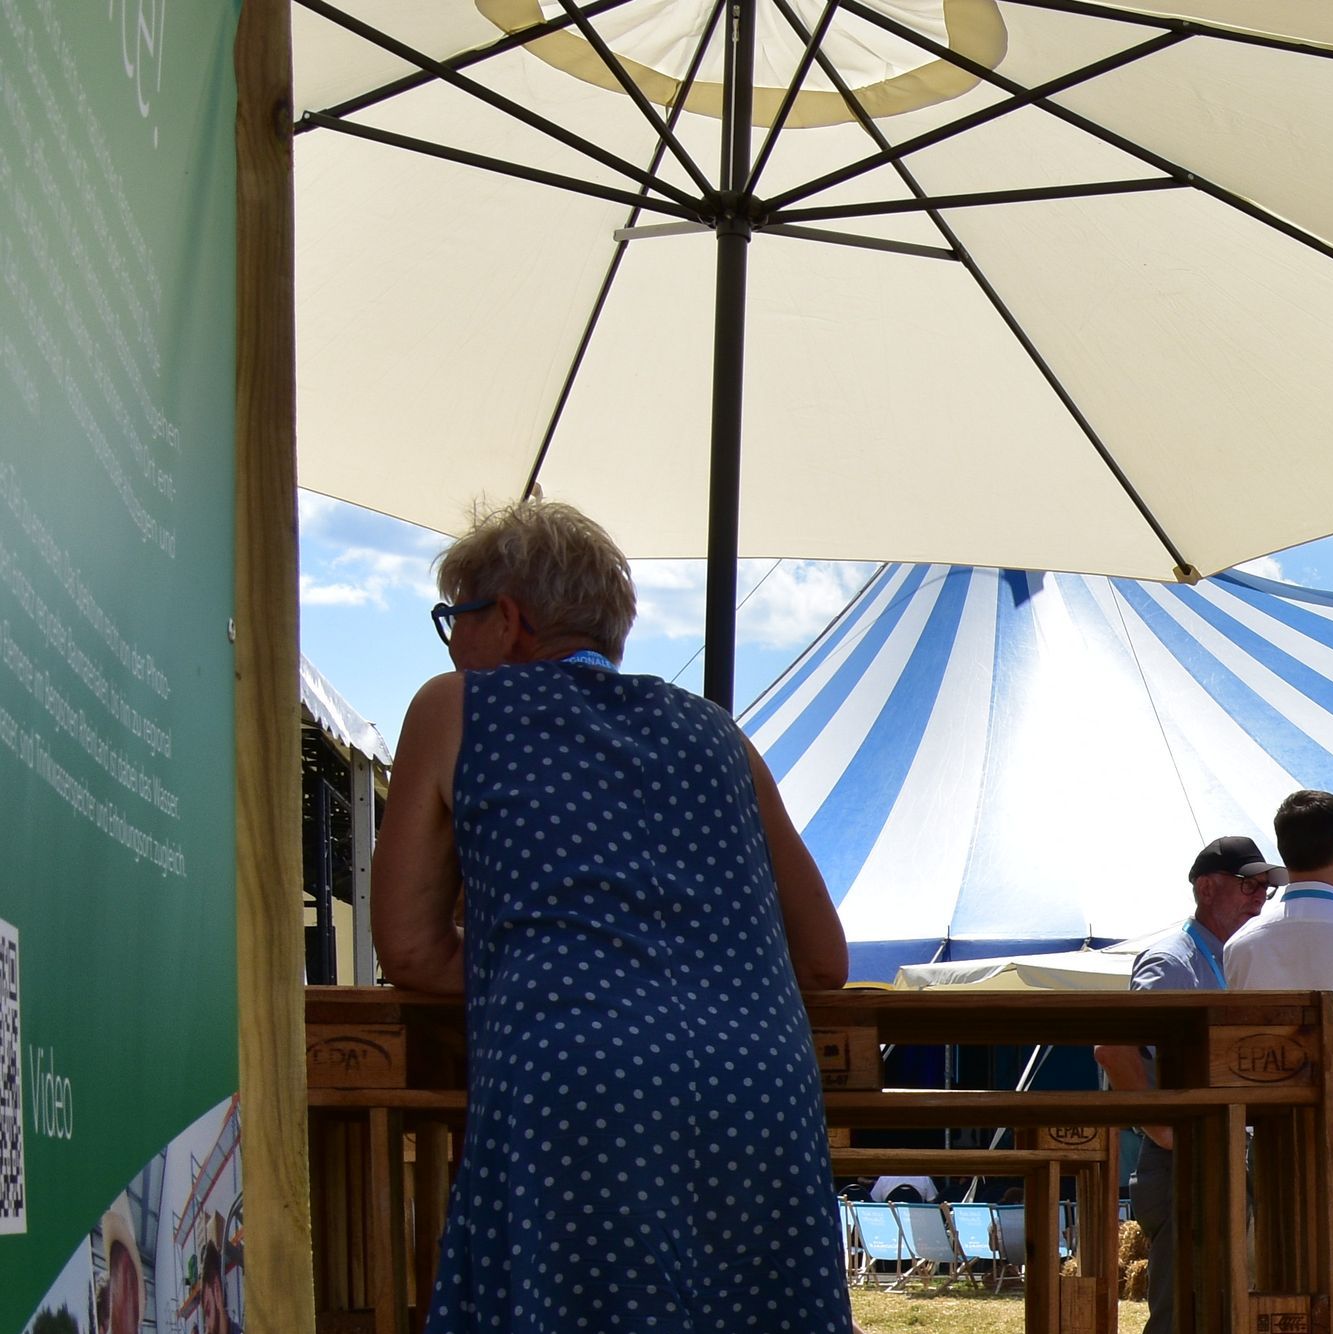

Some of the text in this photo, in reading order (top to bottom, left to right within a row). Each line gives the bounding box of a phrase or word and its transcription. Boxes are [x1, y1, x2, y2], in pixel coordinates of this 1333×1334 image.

[131, 708, 141, 738] zu
[143, 717, 171, 760] regional
[139, 763, 152, 803] das
[108, 802, 152, 862] Erholungsort
[153, 838, 187, 877] zugleich.
[1237, 1045, 1294, 1072] EPAL
[29, 1043, 73, 1140] Video
